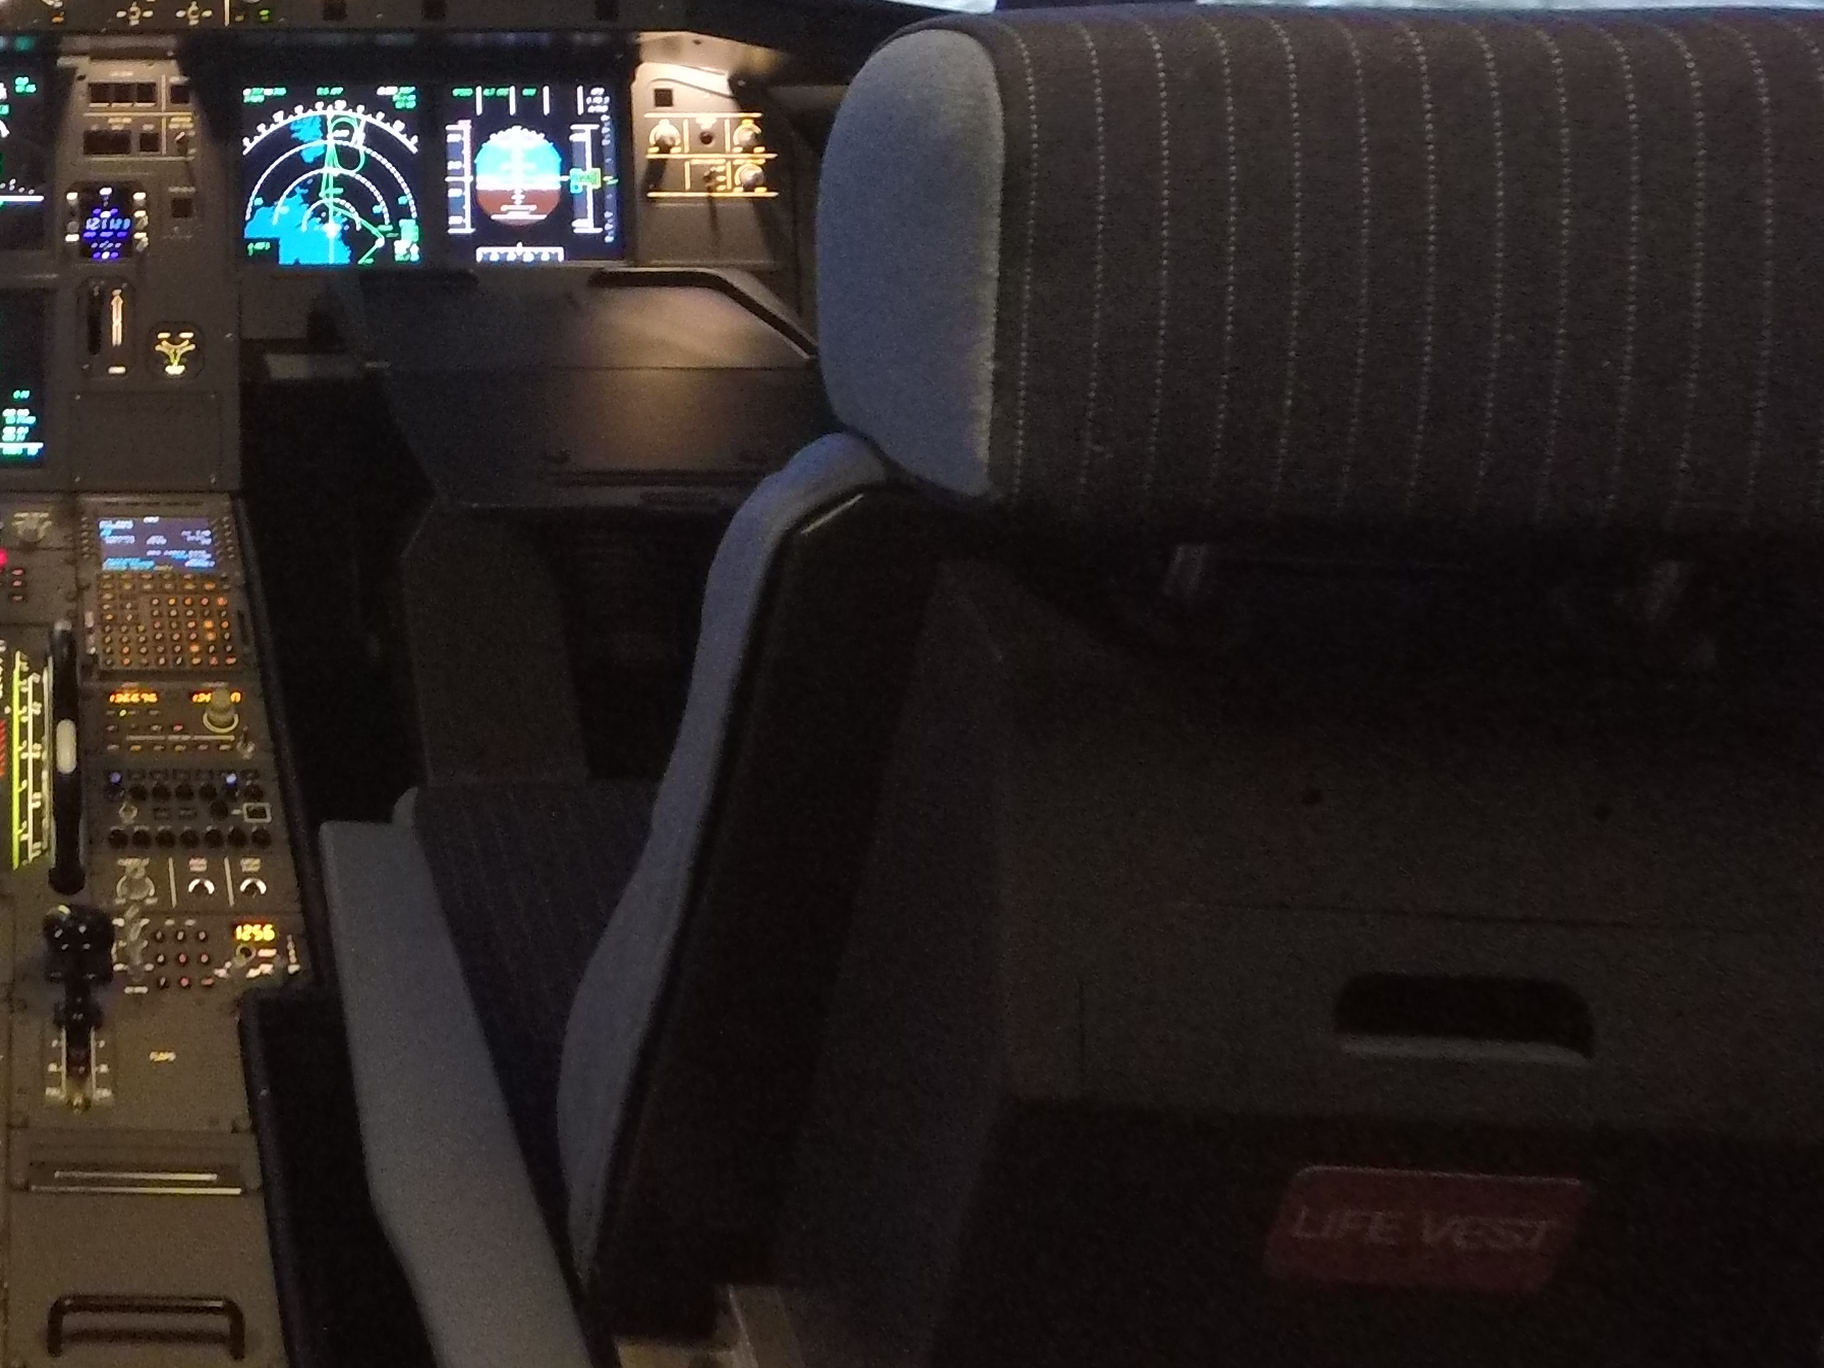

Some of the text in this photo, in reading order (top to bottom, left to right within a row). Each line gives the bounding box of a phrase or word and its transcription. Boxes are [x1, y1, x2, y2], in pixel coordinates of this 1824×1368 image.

[235, 923, 276, 942] 1256
[1292, 1205, 1563, 1251] LIFE VEST
